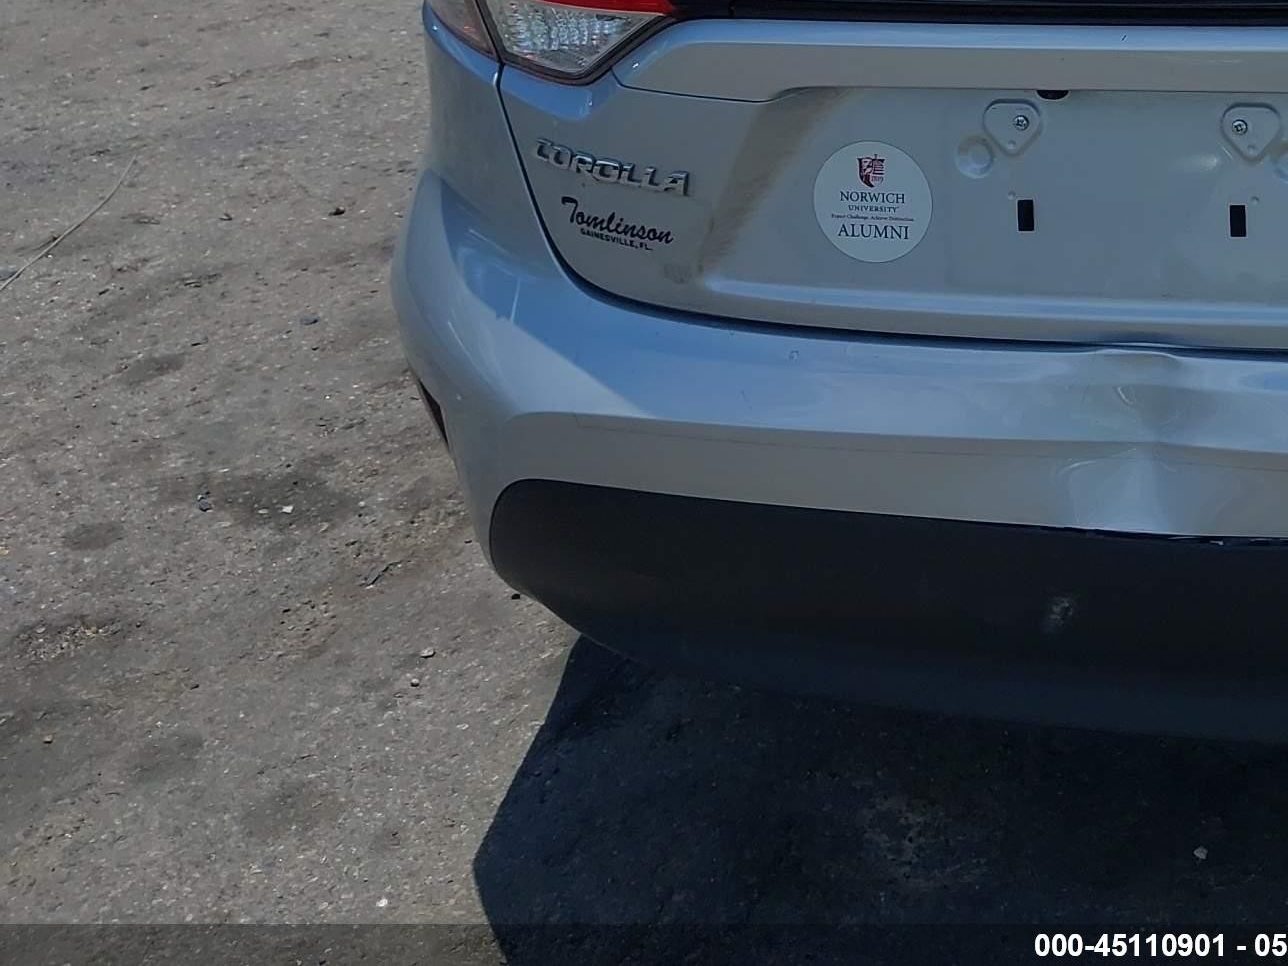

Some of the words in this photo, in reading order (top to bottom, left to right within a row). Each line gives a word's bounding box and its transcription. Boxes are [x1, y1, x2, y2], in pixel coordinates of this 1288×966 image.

[534, 138, 691, 197] COROLLA
[840, 191, 905, 204] NORWICH
[848, 205, 898, 213] UNIVERSITY
[561, 196, 674, 244] Tomlinson
[838, 223, 910, 240] ALUMNI
